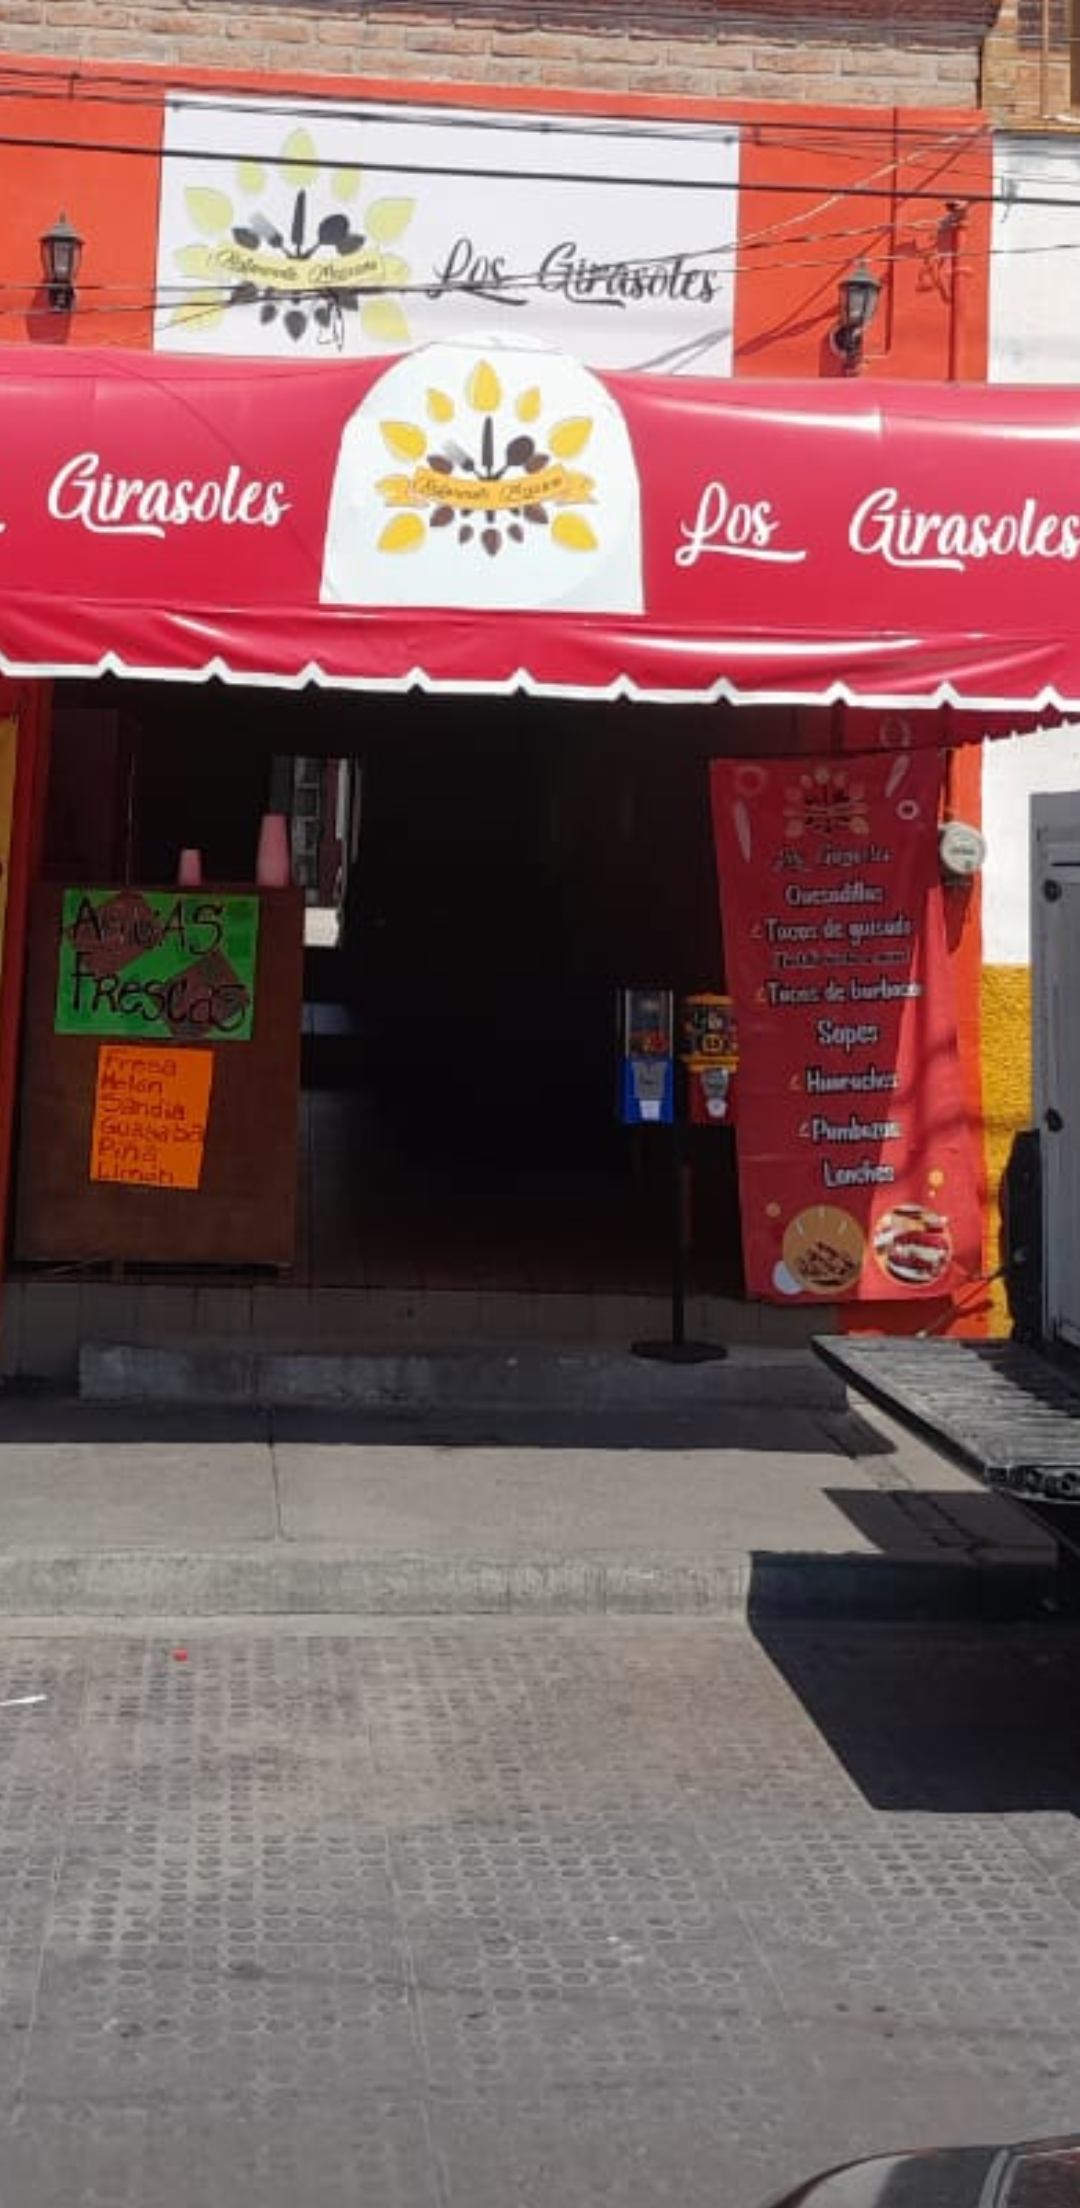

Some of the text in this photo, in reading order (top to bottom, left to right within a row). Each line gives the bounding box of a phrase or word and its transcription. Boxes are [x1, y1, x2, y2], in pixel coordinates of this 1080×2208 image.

[426, 237, 723, 308] Los Girasoles
[47, 450, 293, 539] Girasoles
[675, 481, 1080, 573] Los Girasoles
[766, 916, 818, 943] Tacos
[823, 916, 843, 938] de
[768, 980, 818, 1006] Tacos
[825, 980, 845, 1002] de
[817, 1018, 880, 1052] Sopes
[806, 1065, 901, 1093] Huaraches
[823, 1158, 895, 1188] Lonches
